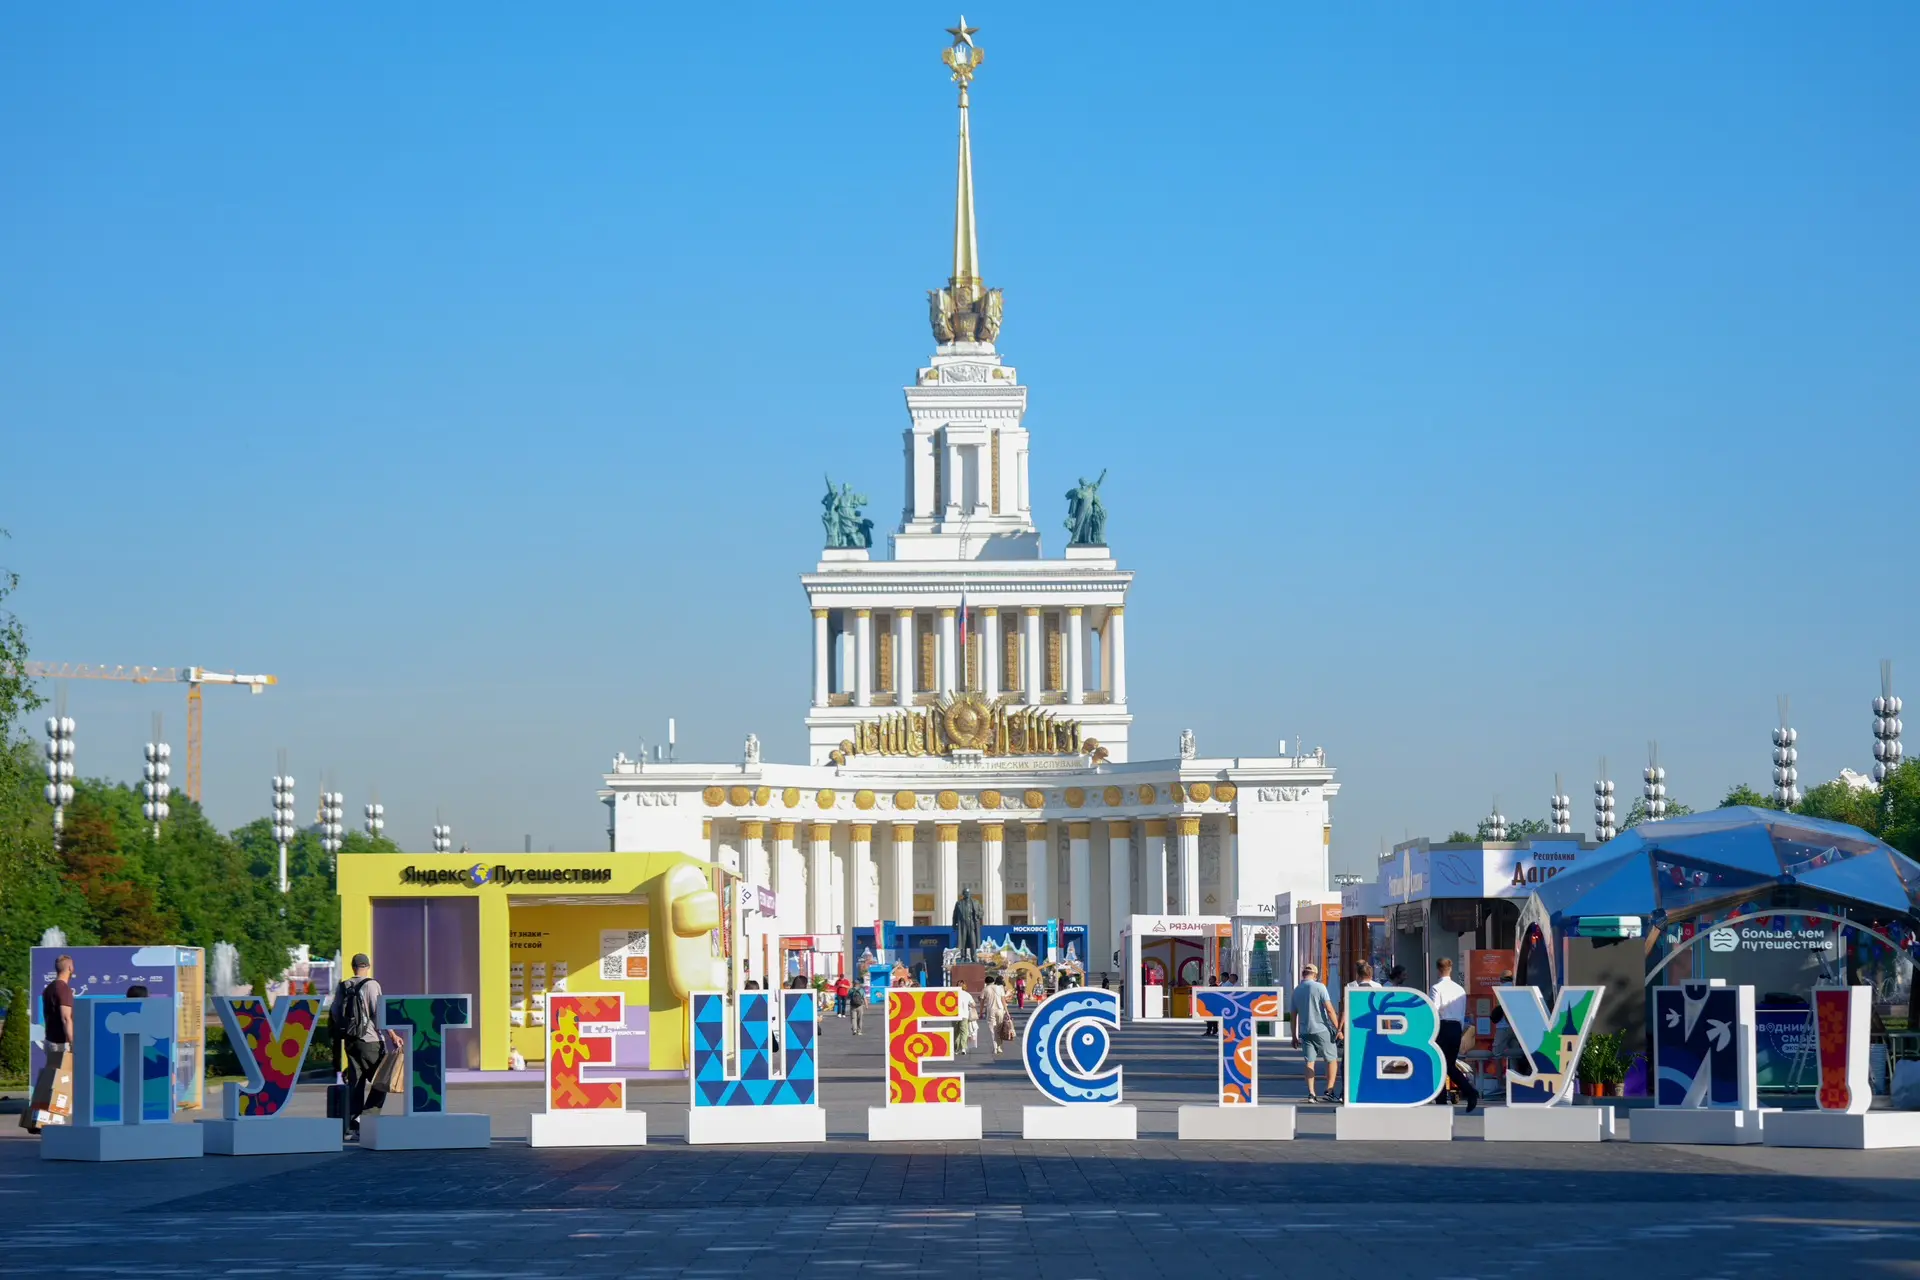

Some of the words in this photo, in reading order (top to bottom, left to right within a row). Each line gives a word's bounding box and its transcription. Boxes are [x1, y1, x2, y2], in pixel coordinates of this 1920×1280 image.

[1533, 851, 1575, 861] Республика
[404, 865, 466, 883] Яндекс
[494, 864, 612, 885] Путешествия
[1511, 861, 1566, 886] Даге
[1798, 929, 1825, 938] чем
[523, 940, 542, 949] свой
[1741, 940, 1834, 951] путешествие
